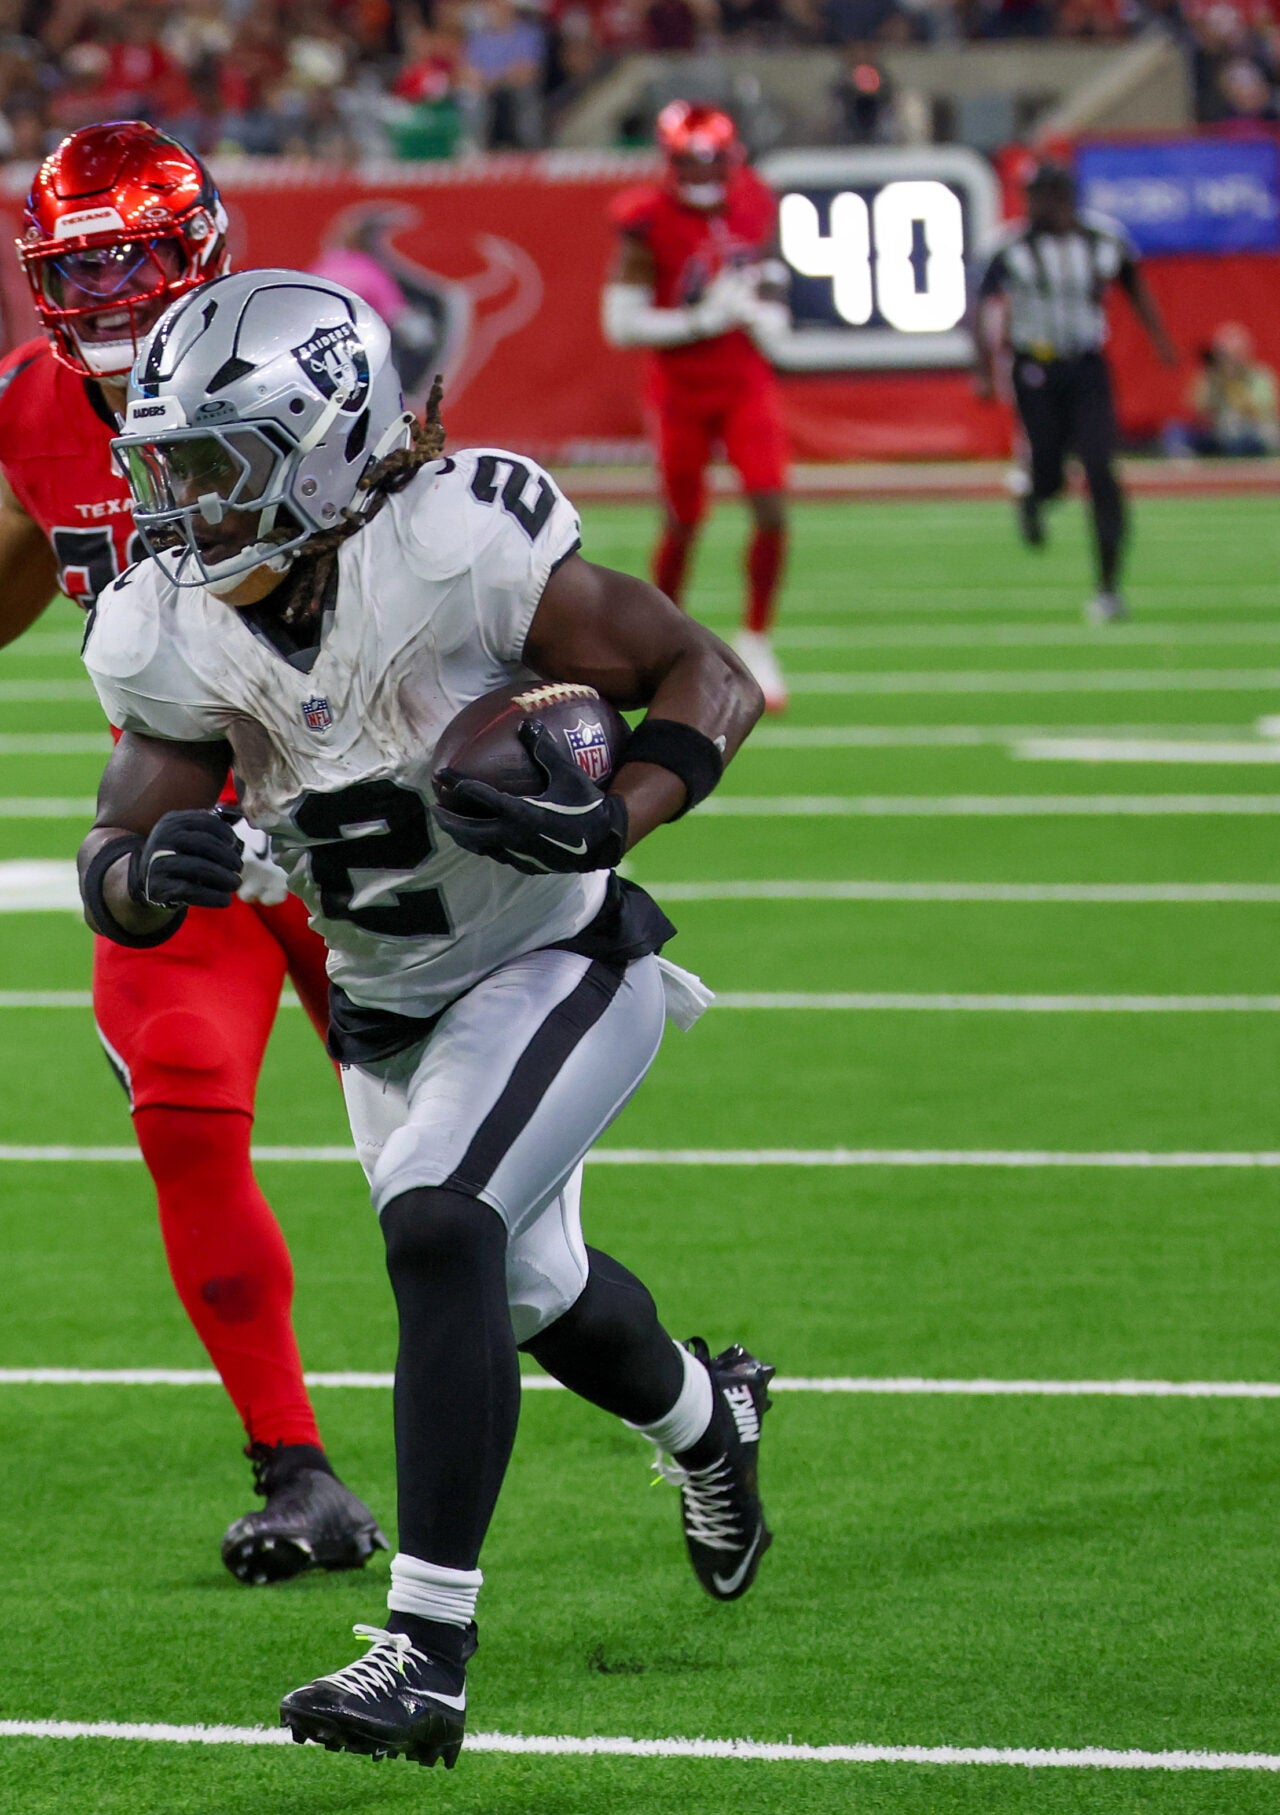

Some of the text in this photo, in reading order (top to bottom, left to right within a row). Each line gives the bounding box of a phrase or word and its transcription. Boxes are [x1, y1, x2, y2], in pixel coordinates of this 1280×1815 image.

[780, 181, 966, 333] 40
[299, 326, 350, 360] RAIDERS
[74, 498, 134, 518] TEXA
[469, 455, 556, 545] 2
[577, 748, 607, 778] NFL
[288, 778, 456, 941] 2
[723, 1384, 760, 1443] NIKE
